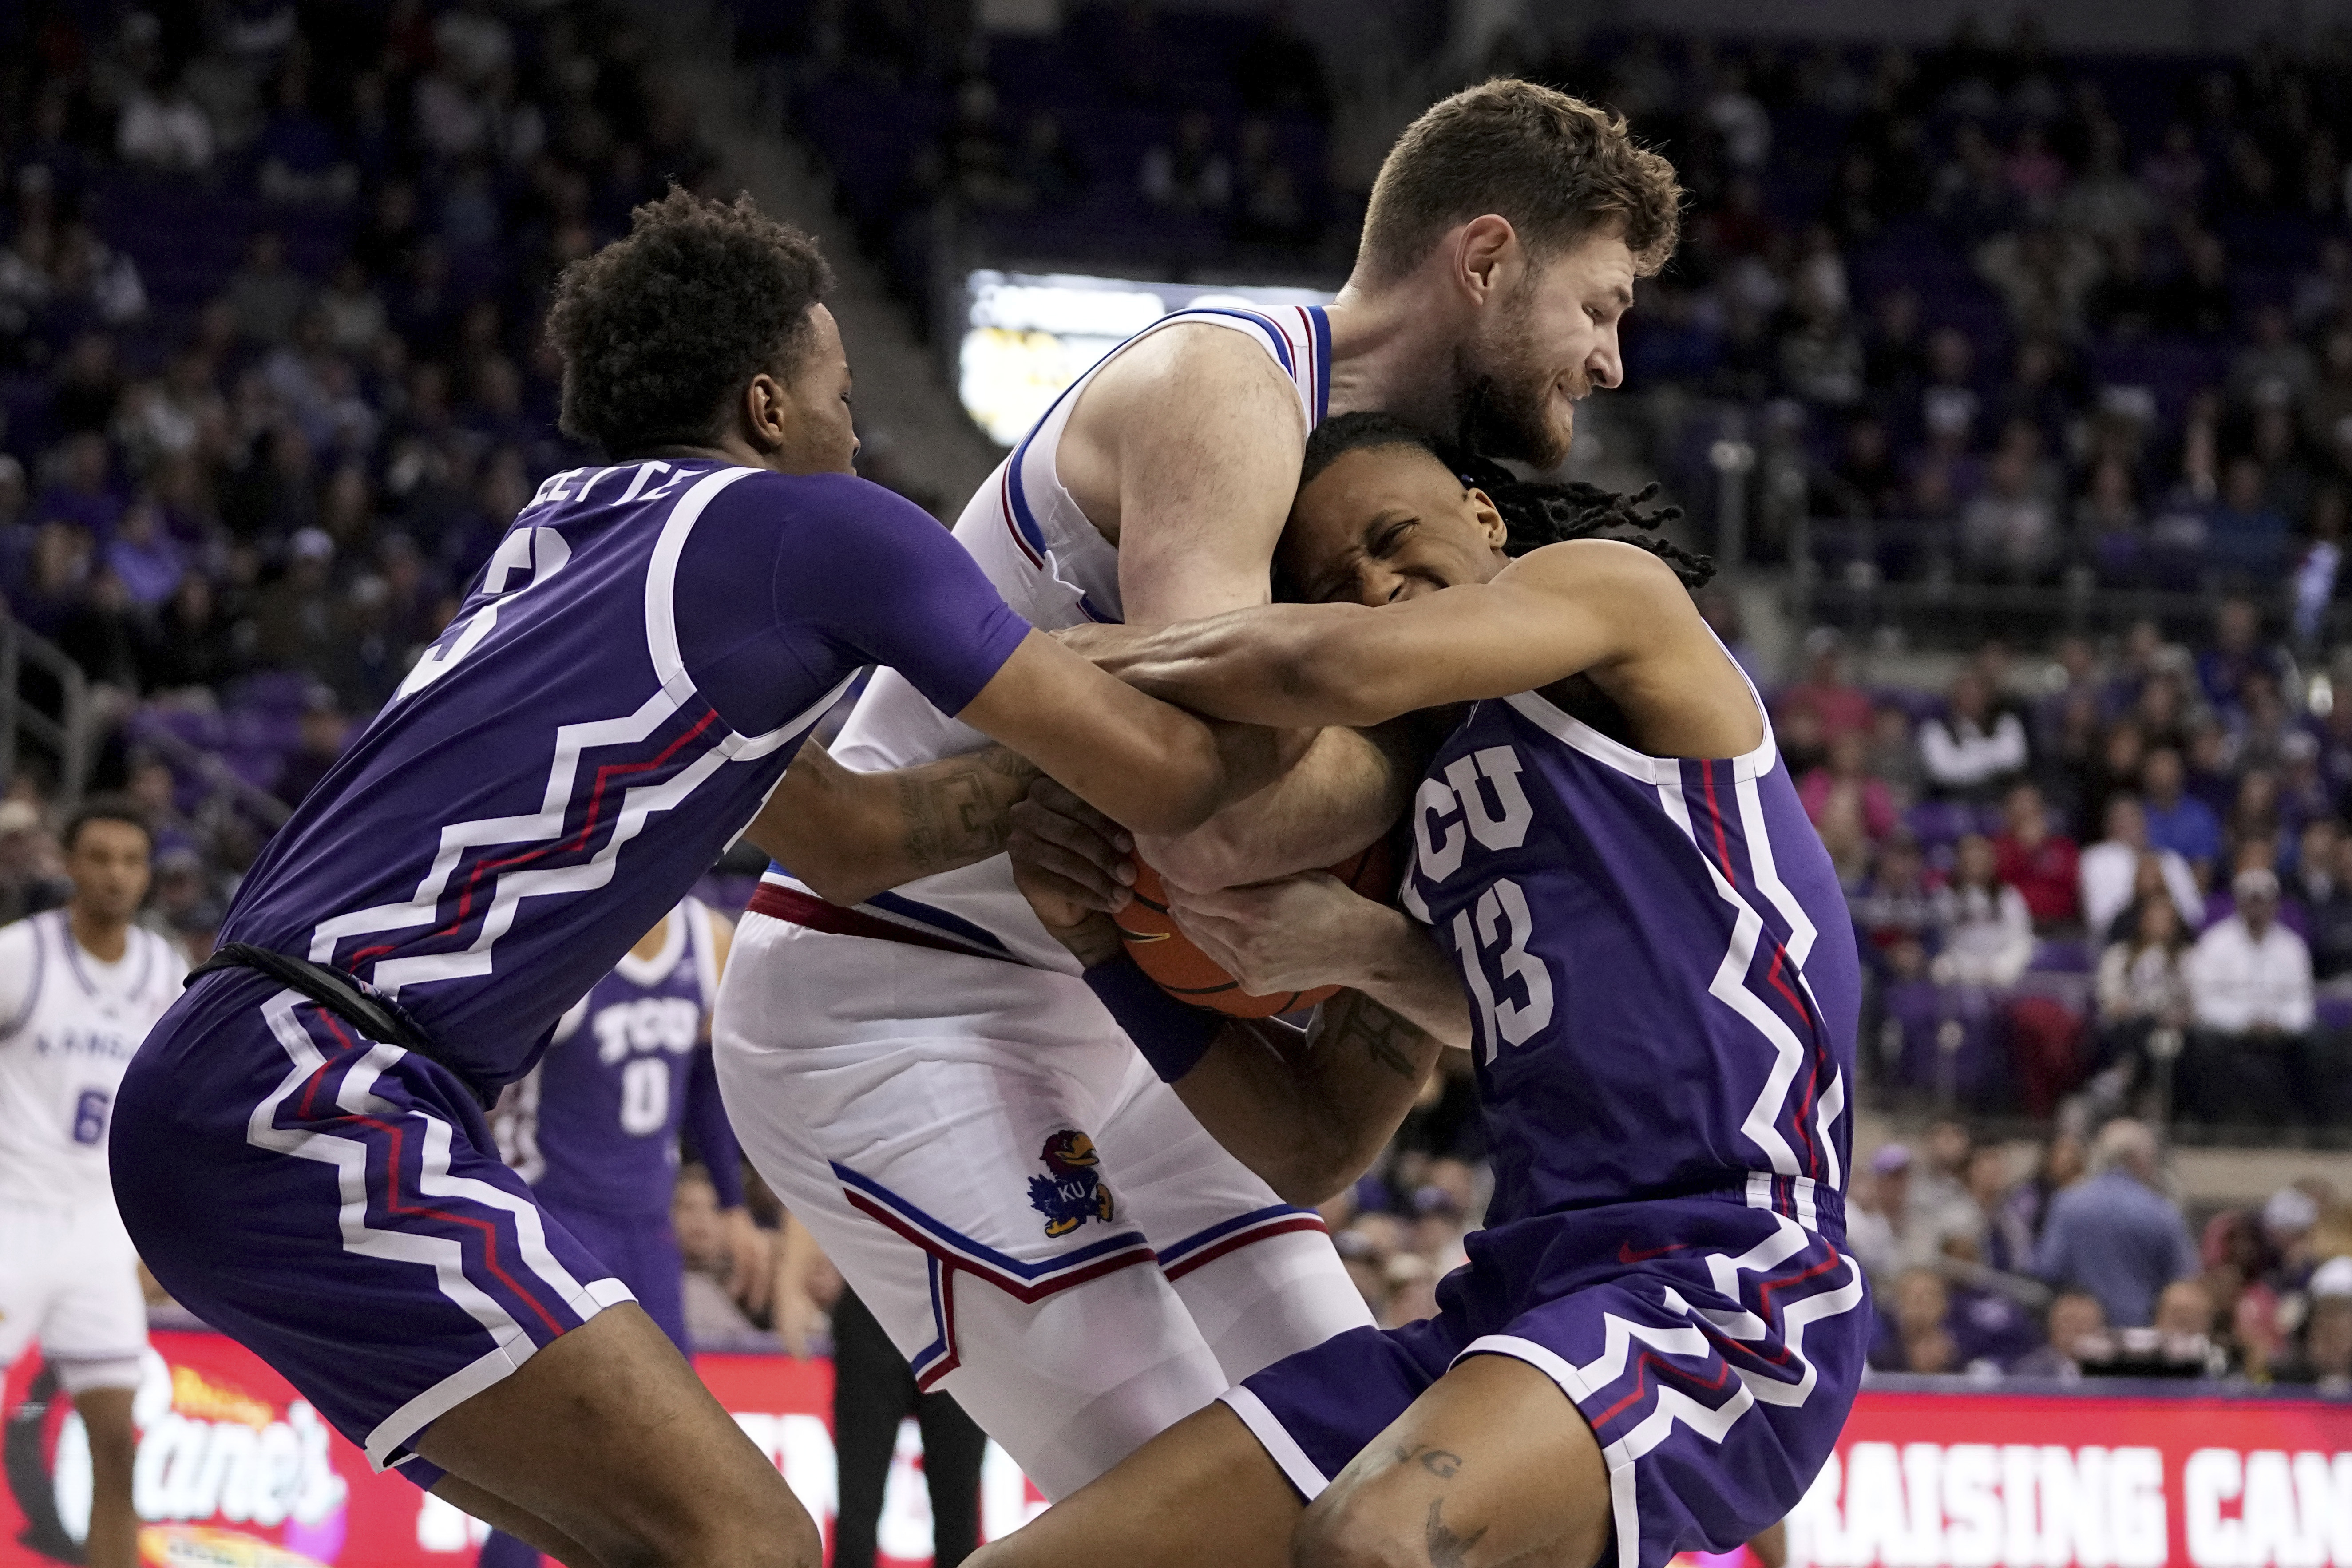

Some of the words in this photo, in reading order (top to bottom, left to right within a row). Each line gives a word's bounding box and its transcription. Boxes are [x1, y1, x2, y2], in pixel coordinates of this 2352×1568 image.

[396, 527, 572, 701] 3
[1453, 878, 1554, 1066] 13
[594, 998, 698, 1065] TCU
[73, 1088, 110, 1144] 6
[622, 1057, 669, 1136] 0
[1057, 1181, 1085, 1203] KU
[1782, 1441, 2169, 1567] RAISING
